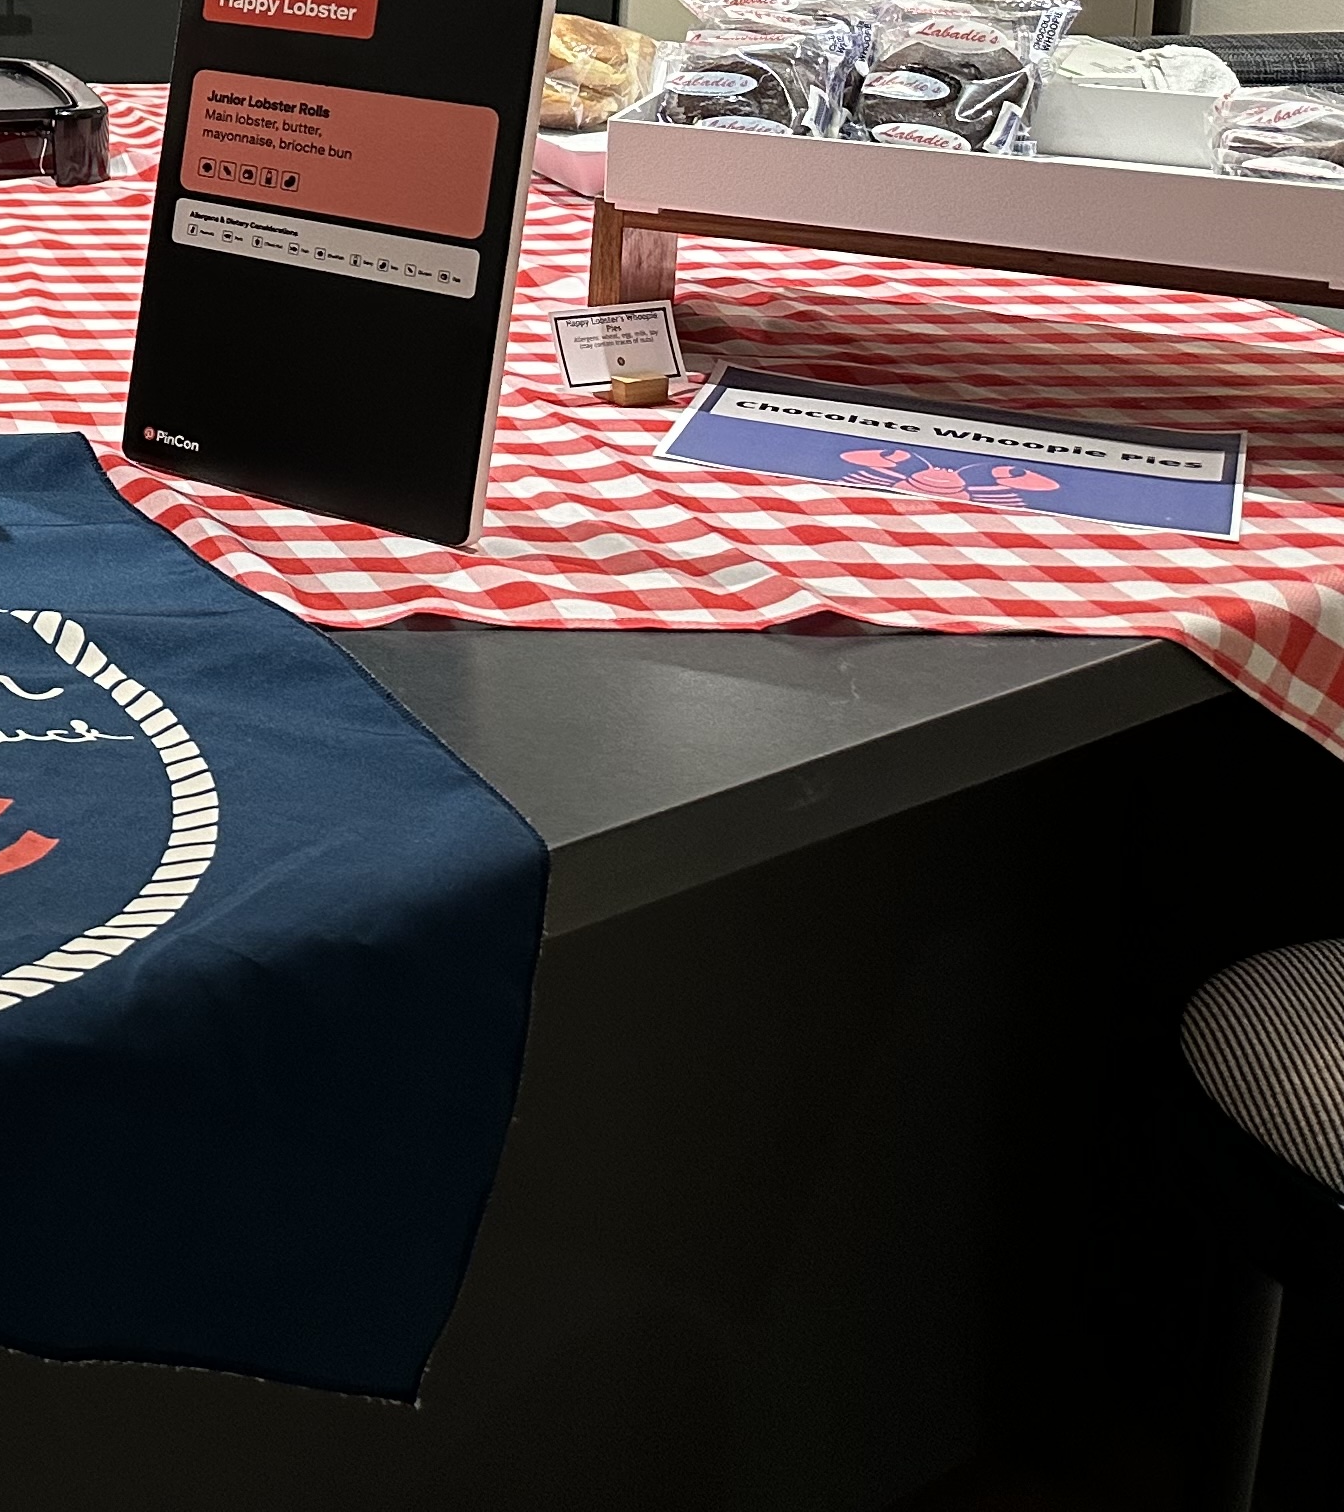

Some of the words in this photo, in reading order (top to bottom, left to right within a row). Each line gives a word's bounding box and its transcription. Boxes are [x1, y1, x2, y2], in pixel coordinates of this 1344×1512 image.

[916, 22, 1000, 45] Labadie's
[666, 74, 749, 88] Labadie's
[207, 90, 246, 107] Junior
[248, 95, 297, 113] Lobster
[299, 102, 331, 119] Rolls
[205, 108, 233, 123] Main
[235, 112, 279, 131] lobster,
[282, 119, 322, 137] butter,
[202, 127, 276, 150] mayonnaise,
[279, 137, 326, 156] brioche
[328, 145, 353, 160] bun
[879, 126, 963, 151] Labadie's
[566, 319, 589, 329] Happy
[592, 315, 625, 326] Lobster's
[606, 324, 623, 333] Pies
[156, 429, 200, 452] PinCon
[736, 399, 921, 434] Chocolate
[933, 425, 1108, 460] Whoopie
[1120, 451, 1204, 469] Pies
